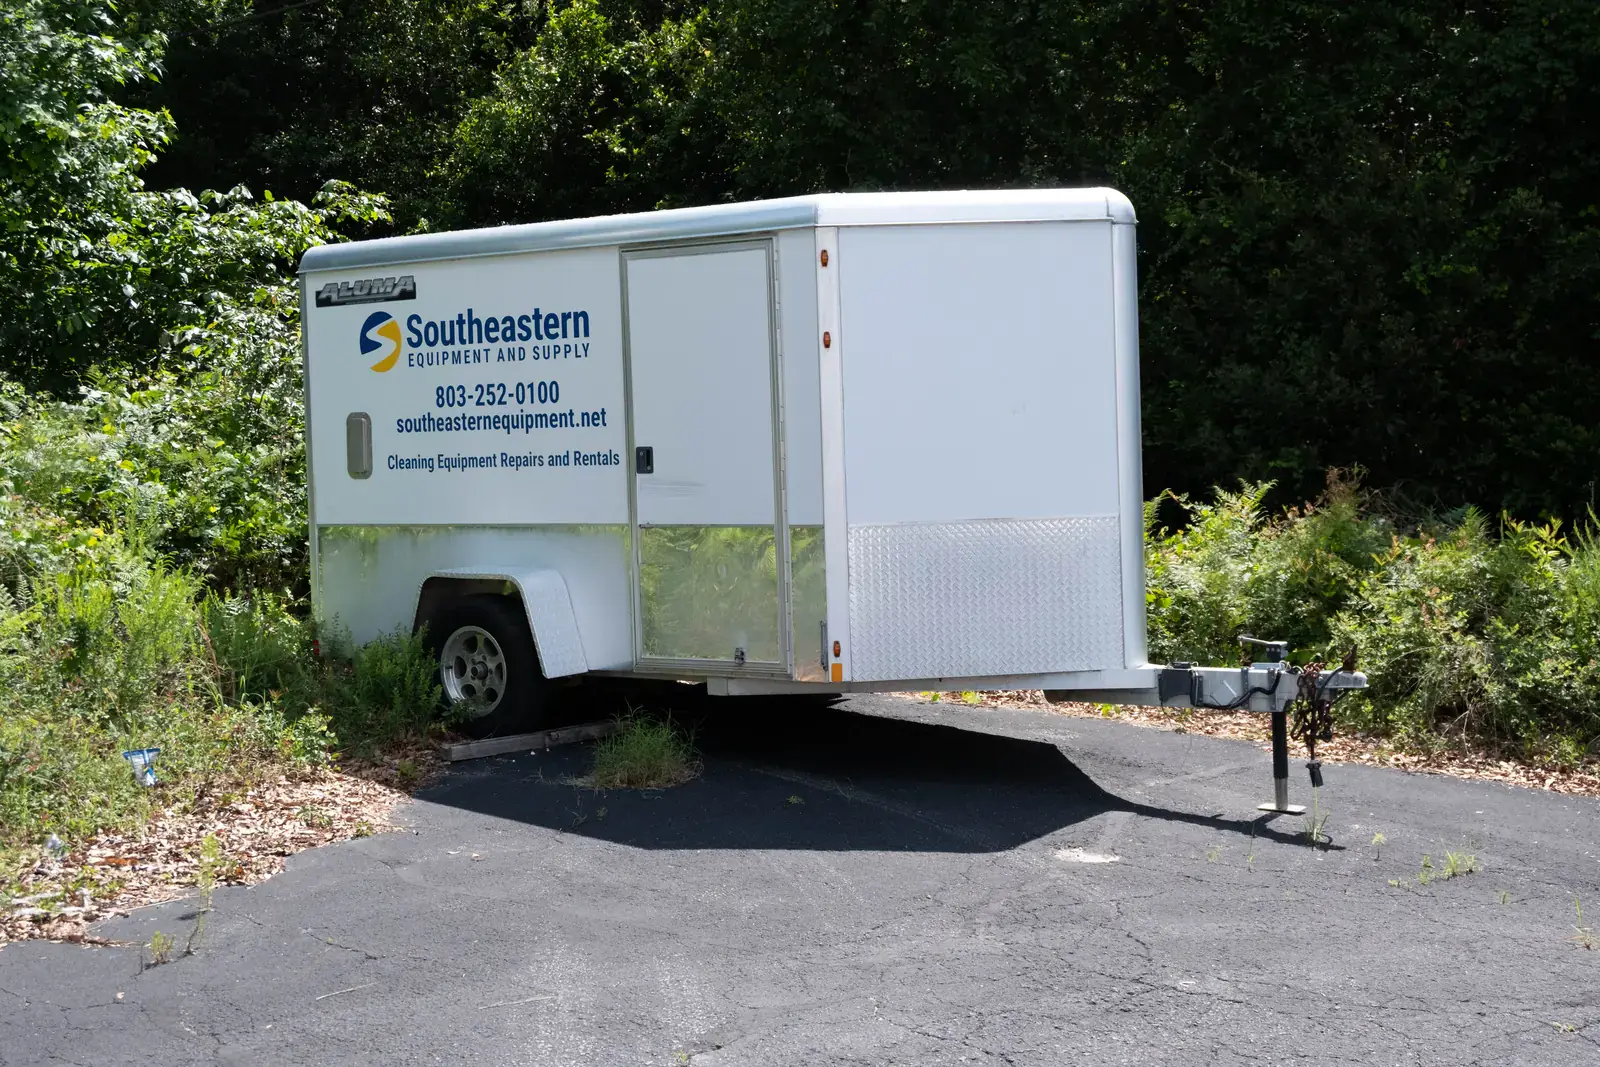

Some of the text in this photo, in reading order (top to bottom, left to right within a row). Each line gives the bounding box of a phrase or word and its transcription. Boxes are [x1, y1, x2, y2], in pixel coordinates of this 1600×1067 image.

[317, 275, 415, 303] ALUMA
[406, 308, 590, 349] Southeastern
[408, 343, 590, 368] EQUIPMENT AND SUPPLY
[435, 380, 560, 408] 803-252-0100
[396, 408, 607, 434] southeasternequipment.net
[387, 449, 620, 473] Cleaning Equipment Repairs and Rentals
